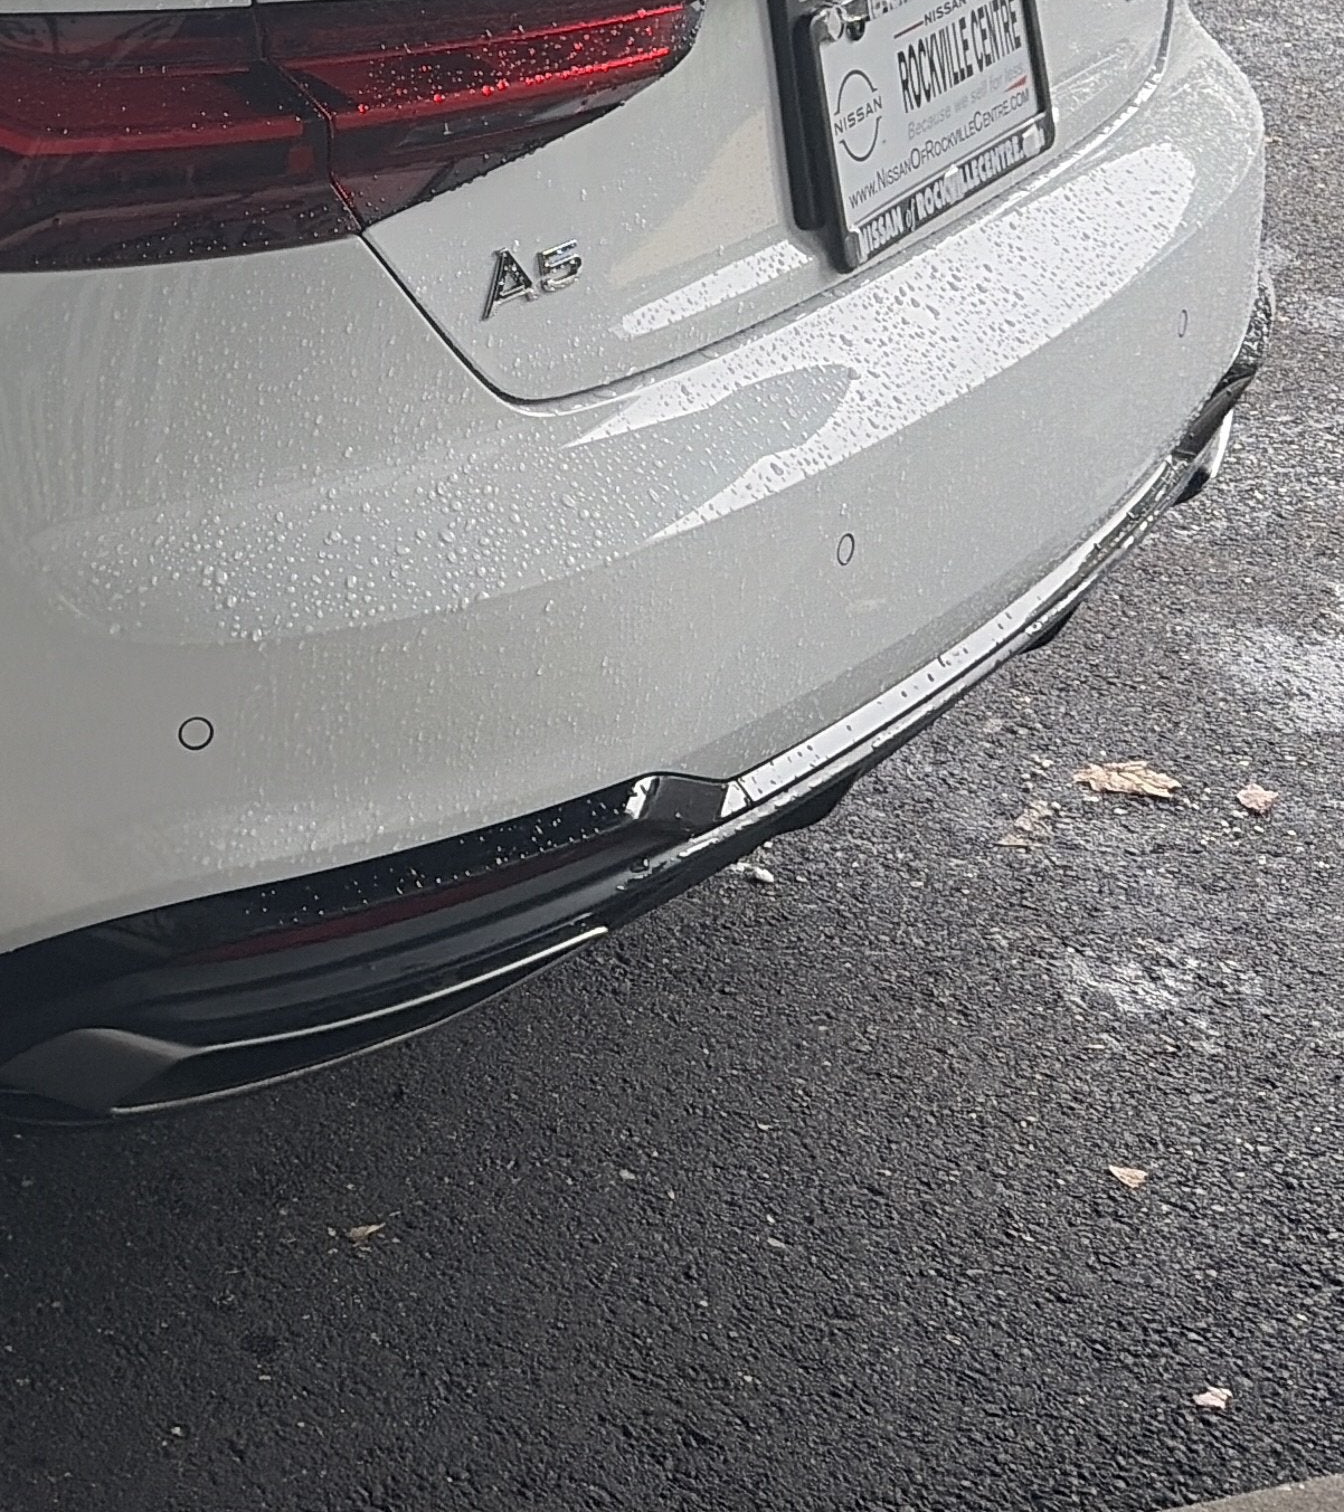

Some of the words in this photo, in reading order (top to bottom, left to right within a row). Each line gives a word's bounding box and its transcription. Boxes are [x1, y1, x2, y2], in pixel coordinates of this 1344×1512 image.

[897, 16, 974, 113] ROCKVILLE
[834, 95, 883, 136] NISSAN
[857, 205, 904, 264] NISSAN
[480, 239, 582, 321] A5
